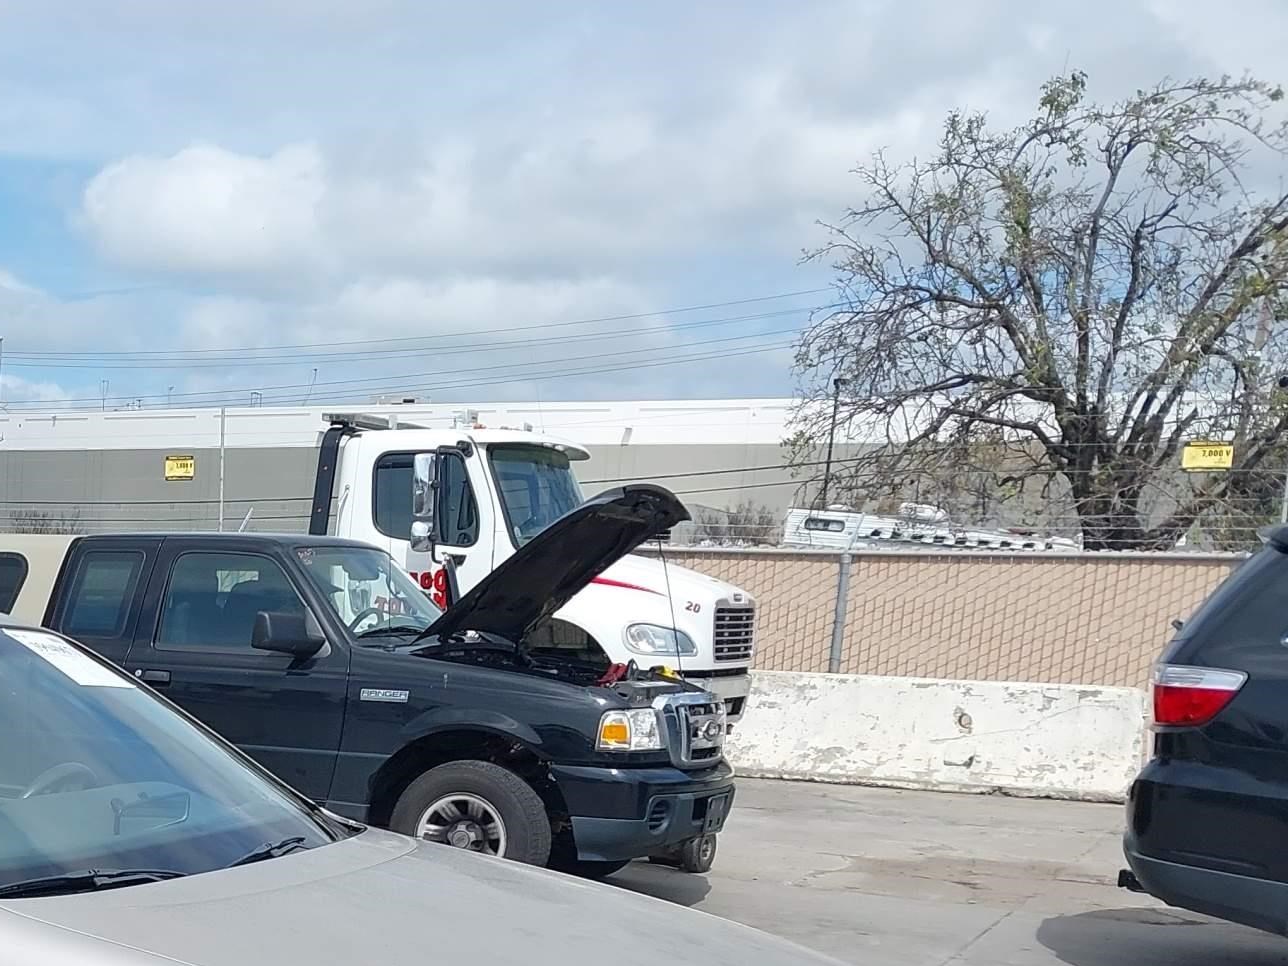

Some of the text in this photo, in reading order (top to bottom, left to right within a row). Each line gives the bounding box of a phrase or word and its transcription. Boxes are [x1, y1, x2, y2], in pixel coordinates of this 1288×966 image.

[1202, 449, 1223, 457] 7,000
[685, 600, 701, 613] 20
[362, 689, 408, 699] RANGER
